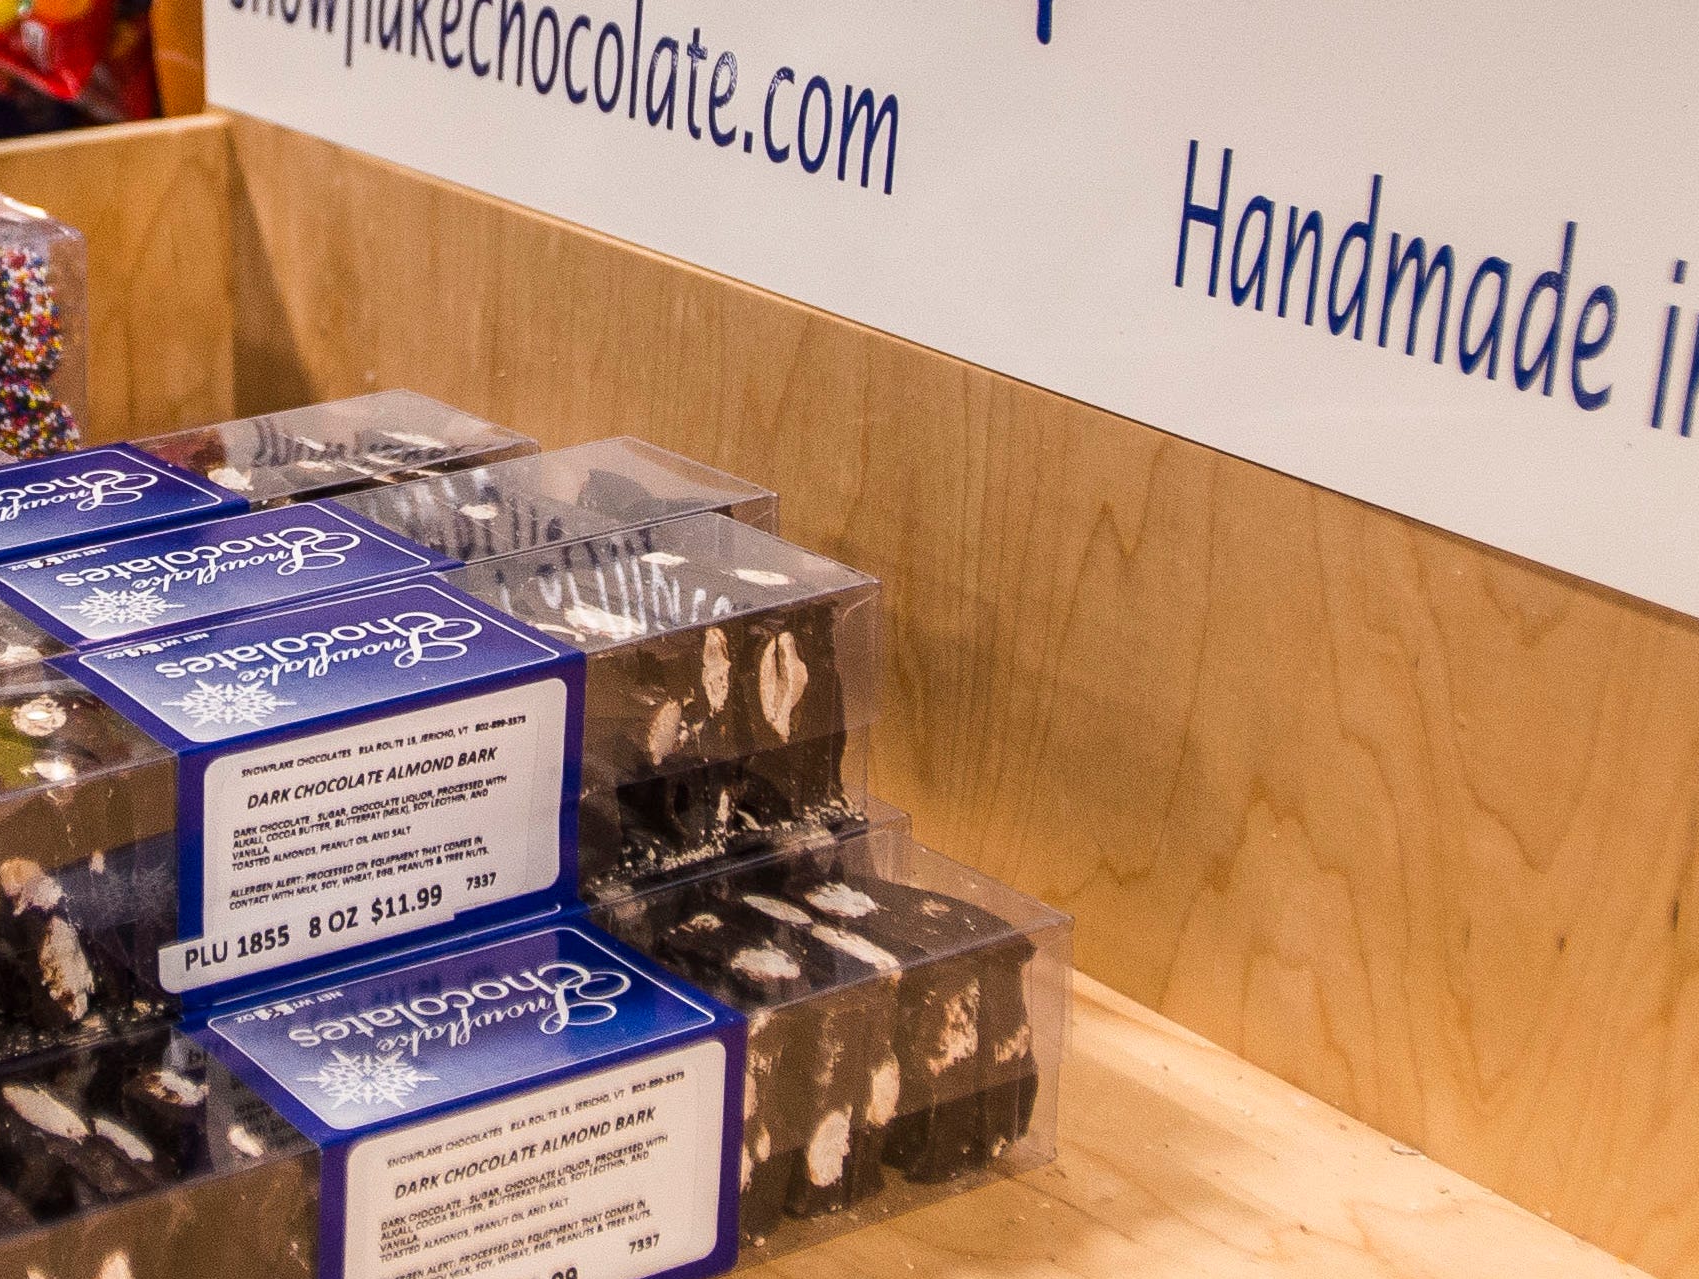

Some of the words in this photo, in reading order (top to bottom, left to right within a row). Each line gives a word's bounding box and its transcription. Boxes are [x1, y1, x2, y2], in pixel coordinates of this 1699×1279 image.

[1171, 139, 1618, 411] Handmade
[55, 524, 326, 588] Chocolates
[130, 531, 360, 592] Snowflake
[154, 611, 444, 682] Chocolates
[236, 618, 483, 686] Snowflake
[247, 786, 291, 810] DARK
[294, 768, 383, 800] CHOCOLATE
[386, 754, 453, 781] ALMOND
[457, 745, 497, 767] BARK
[297, 748, 350, 766] CHOCOLATES
[458, 726, 468, 736] VT
[185, 939, 227, 972] PLU
[237, 923, 290, 958] 1855
[308, 915, 321, 939] 8
[328, 906, 358, 934] OZ
[371, 885, 442, 926] $11.99
[465, 870, 496, 892] 7337
[287, 959, 591, 1050] Chocolates
[375, 968, 632, 1056] Snowflake
[395, 1171, 441, 1200] DARK
[444, 1142, 536, 1185] CHOCOLATE
[540, 1119, 611, 1155] ALMOND
[615, 1106, 656, 1132] BARK
[445, 1125, 502, 1152] CHOCOLATES
[629, 1231, 659, 1255] 7337
